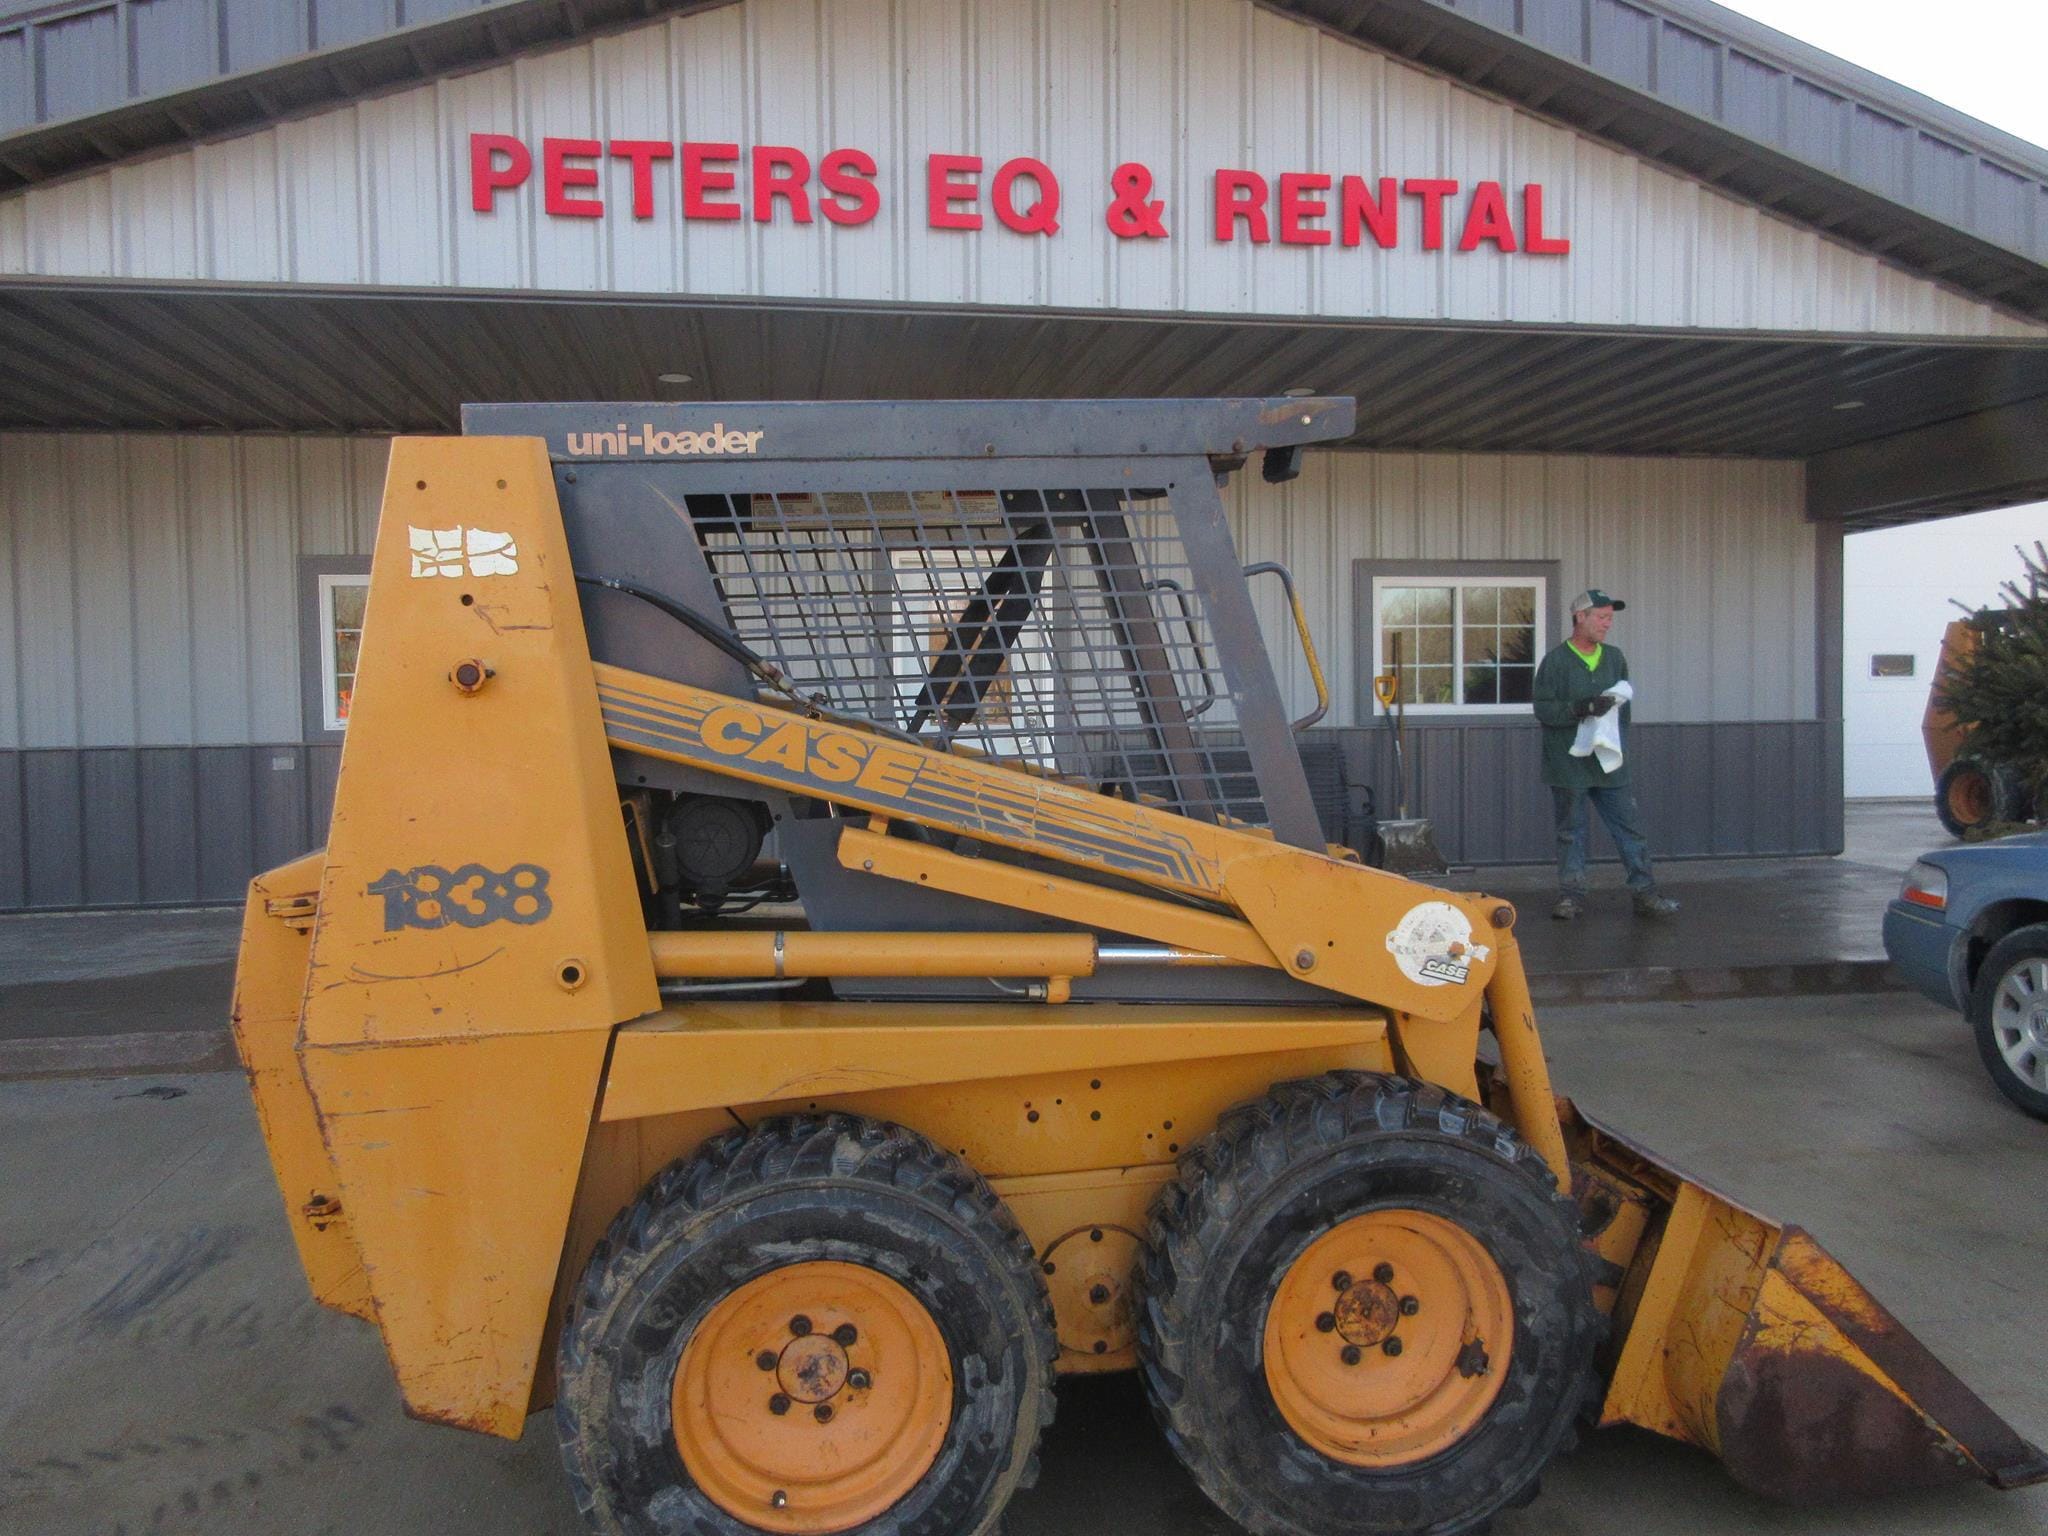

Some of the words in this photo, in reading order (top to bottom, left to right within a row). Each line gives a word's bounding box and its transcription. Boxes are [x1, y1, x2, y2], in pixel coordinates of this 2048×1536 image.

[470, 133, 880, 226] PETERS
[929, 154, 1060, 237] EQ
[1106, 162, 1169, 239] &
[1216, 169, 1570, 255] RENTAL
[567, 423, 764, 455] uni-loader
[700, 705, 926, 798] CASE
[367, 863, 553, 932] 1838
[1426, 959, 1468, 978] CASE
